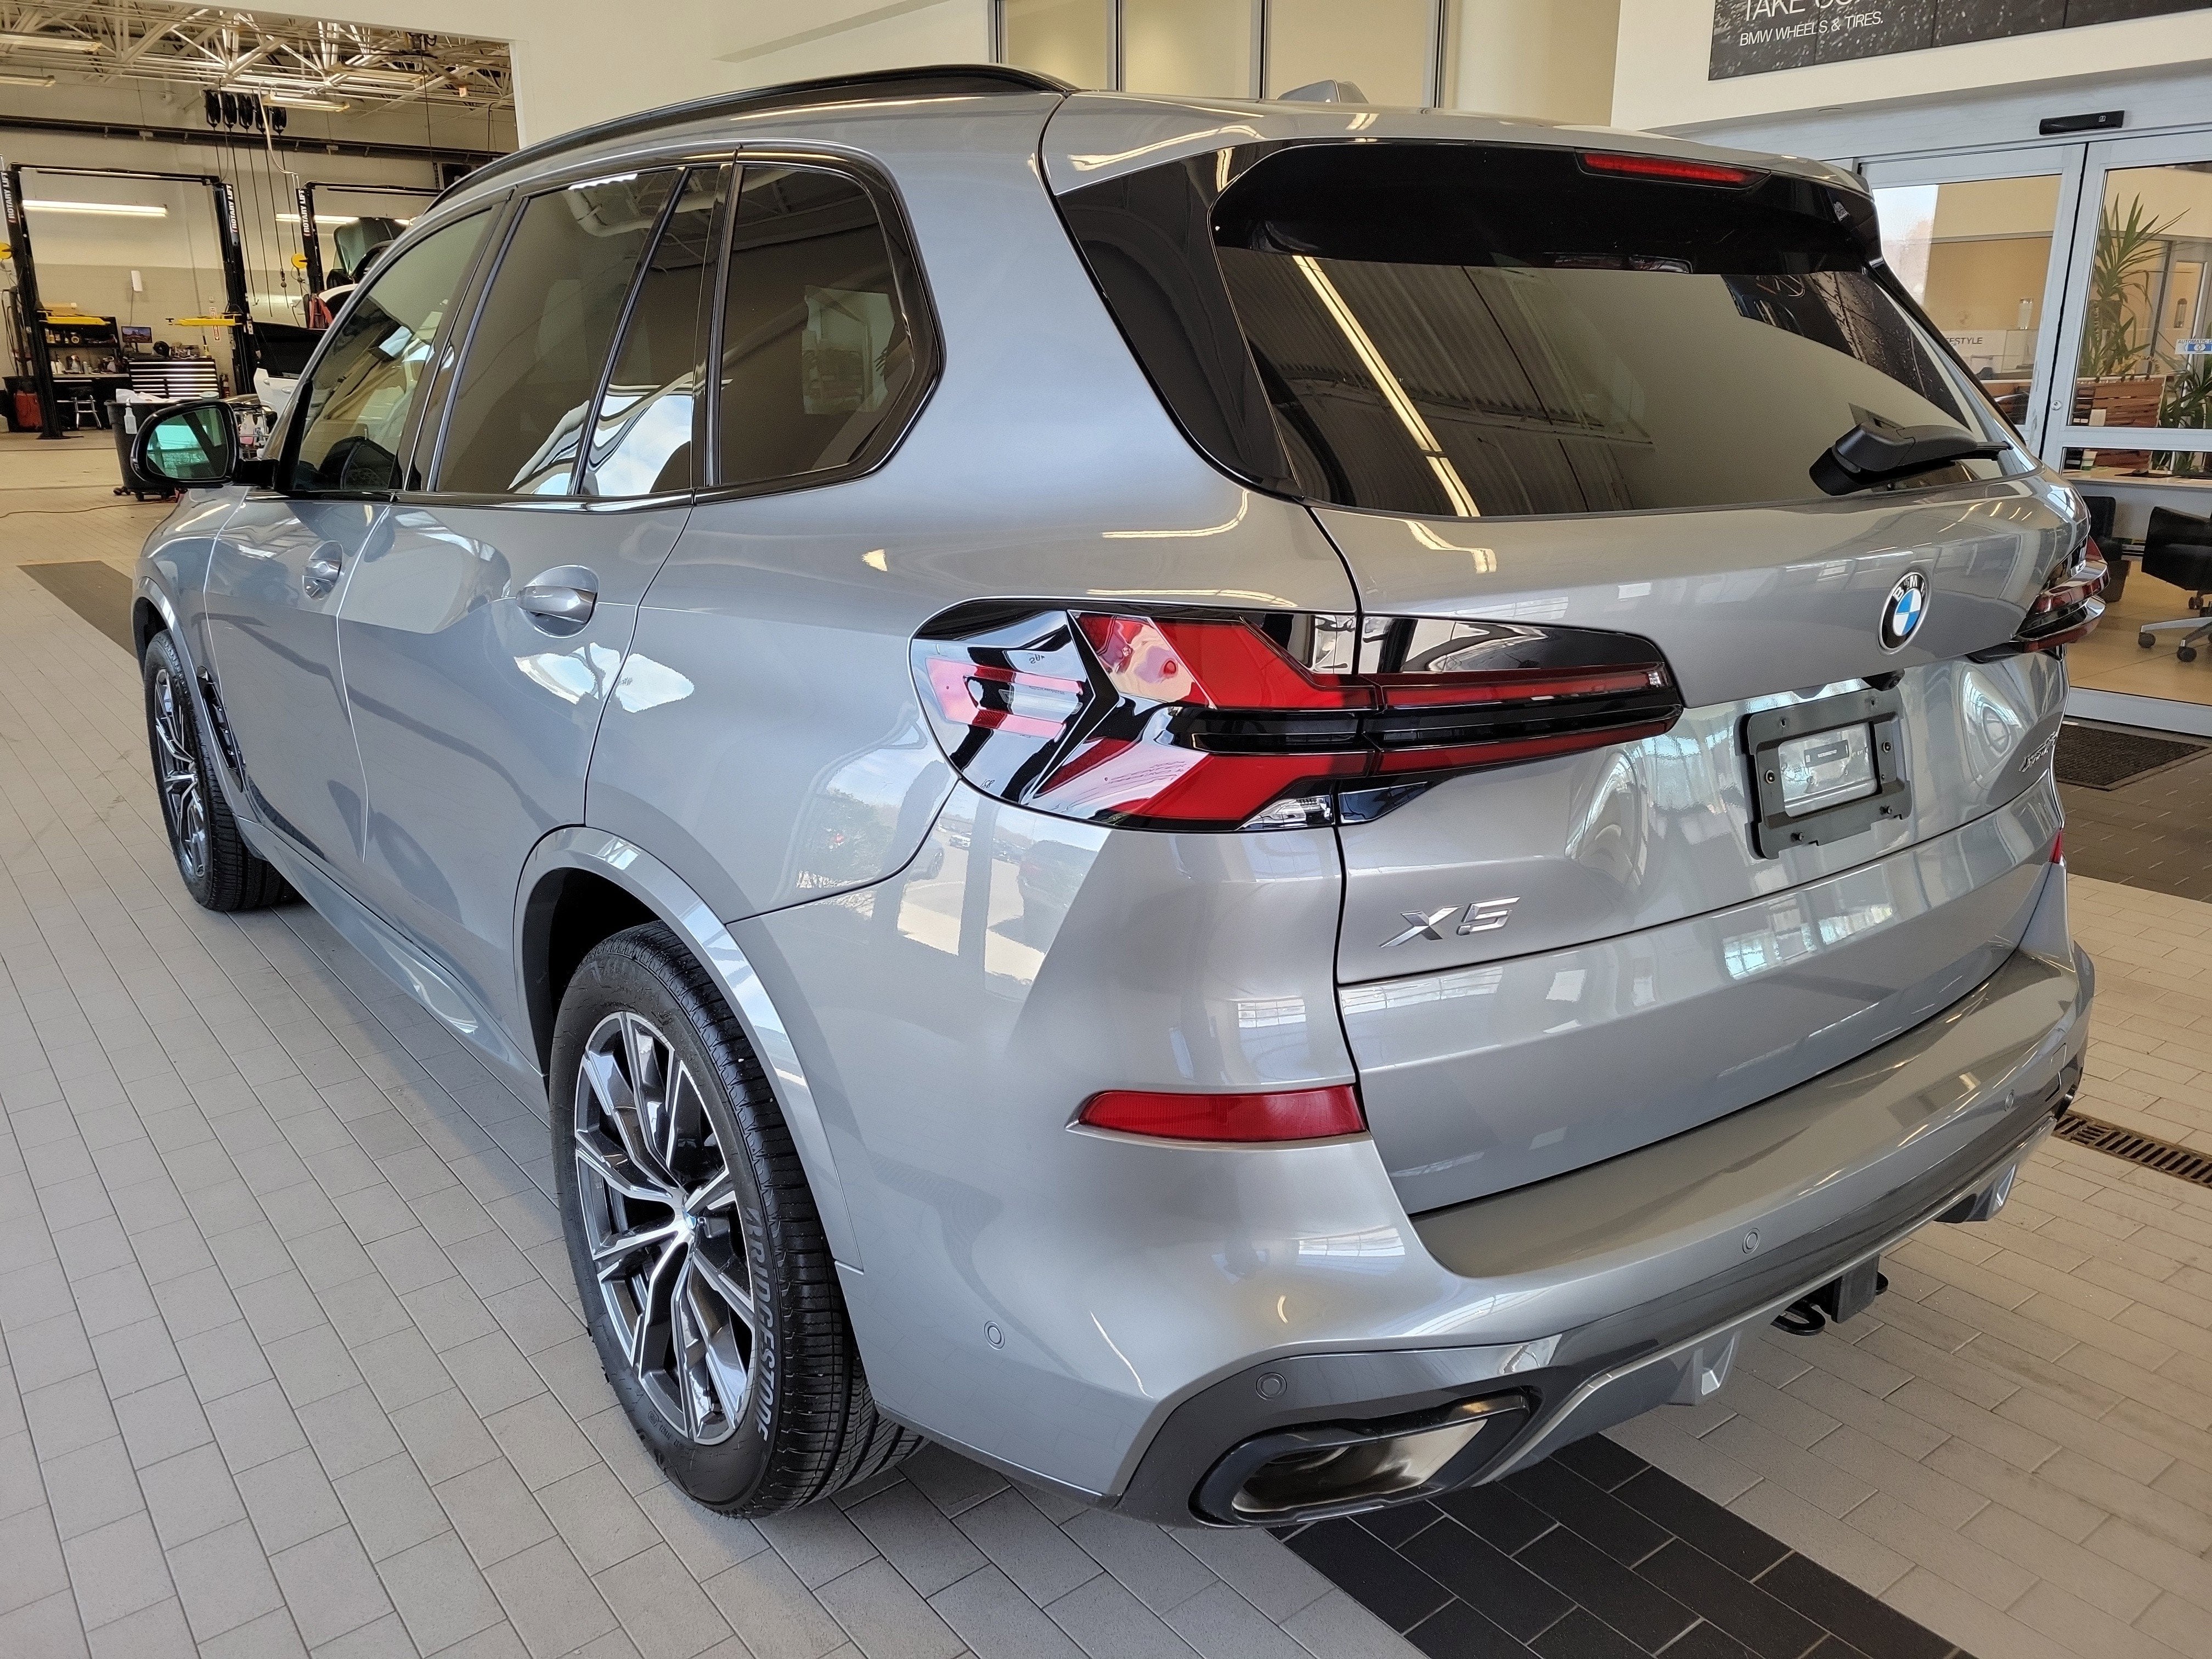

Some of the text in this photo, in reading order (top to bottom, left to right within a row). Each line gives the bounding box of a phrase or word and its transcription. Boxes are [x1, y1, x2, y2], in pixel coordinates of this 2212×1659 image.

[1740, 11, 1884, 46] BMW WHEELS & TIRES.
[1, 172, 15, 219] ROTARY LIFT
[228, 200, 238, 228] ROTARY
[300, 205, 311, 233] ROTARY
[1379, 896, 1520, 948] X5
[746, 1207, 775, 1442] BRIDGESTONE
